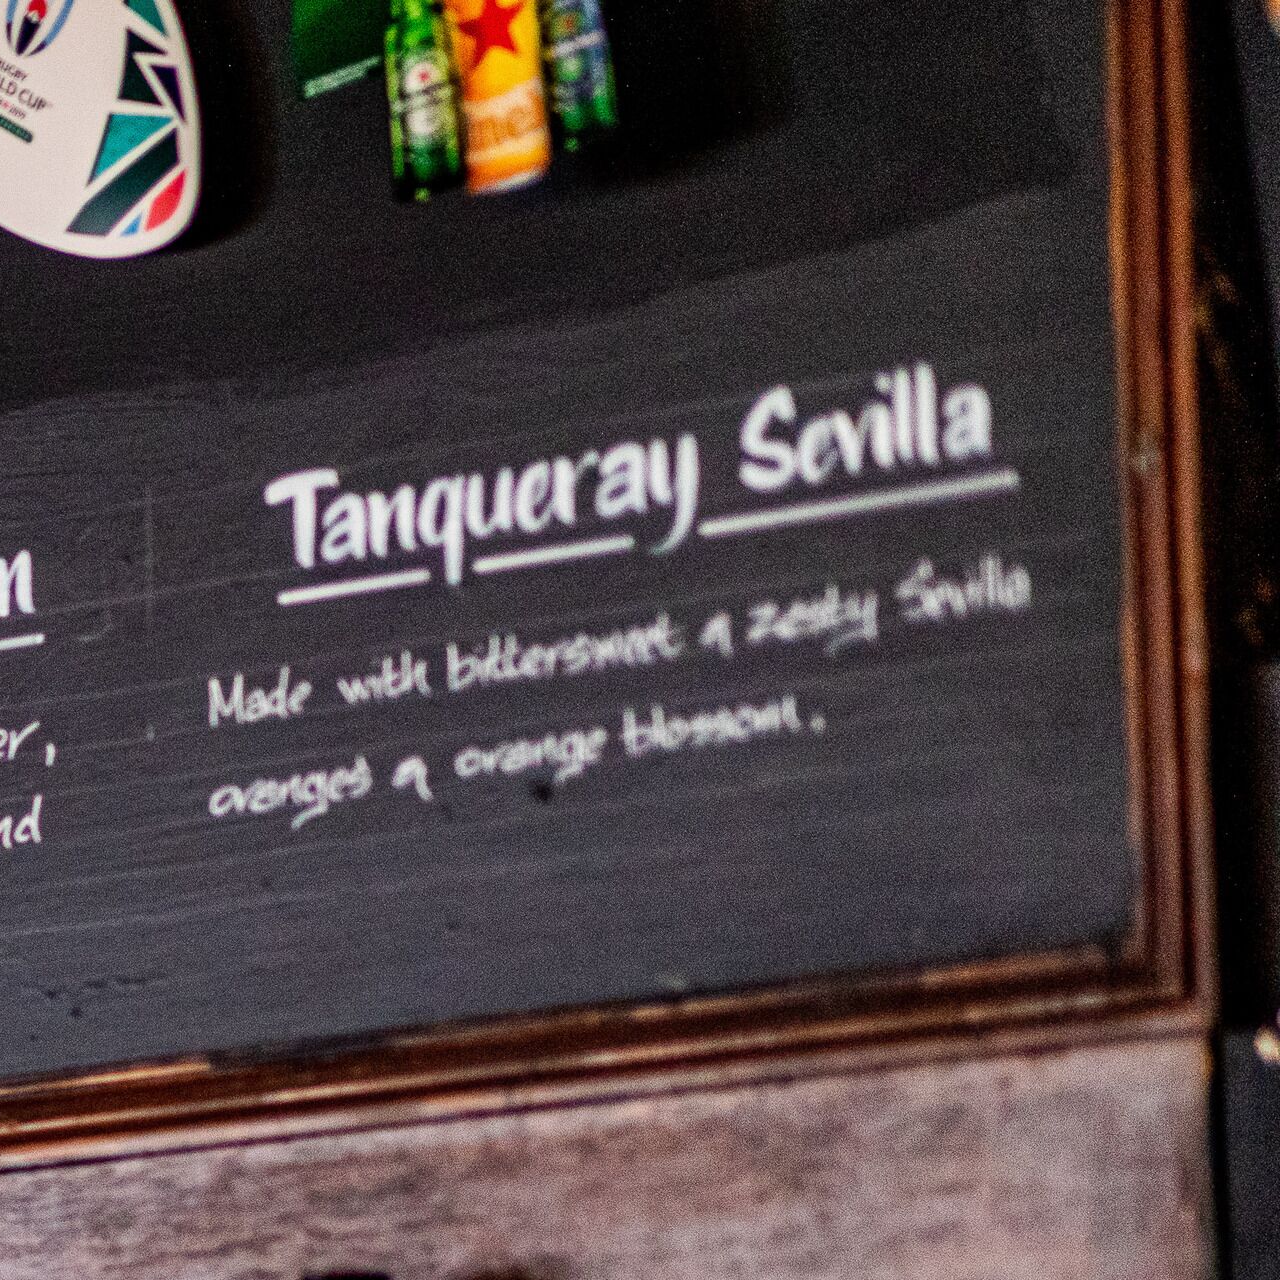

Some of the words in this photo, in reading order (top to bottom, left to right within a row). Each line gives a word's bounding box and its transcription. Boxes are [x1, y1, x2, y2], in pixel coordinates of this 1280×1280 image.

[18, 88, 48, 111] CUP
[265, 432, 700, 586] Tanqueray
[739, 362, 992, 492] Sevilla
[208, 666, 312, 727] Made
[337, 648, 430, 704] with
[453, 726, 608, 786] orange
